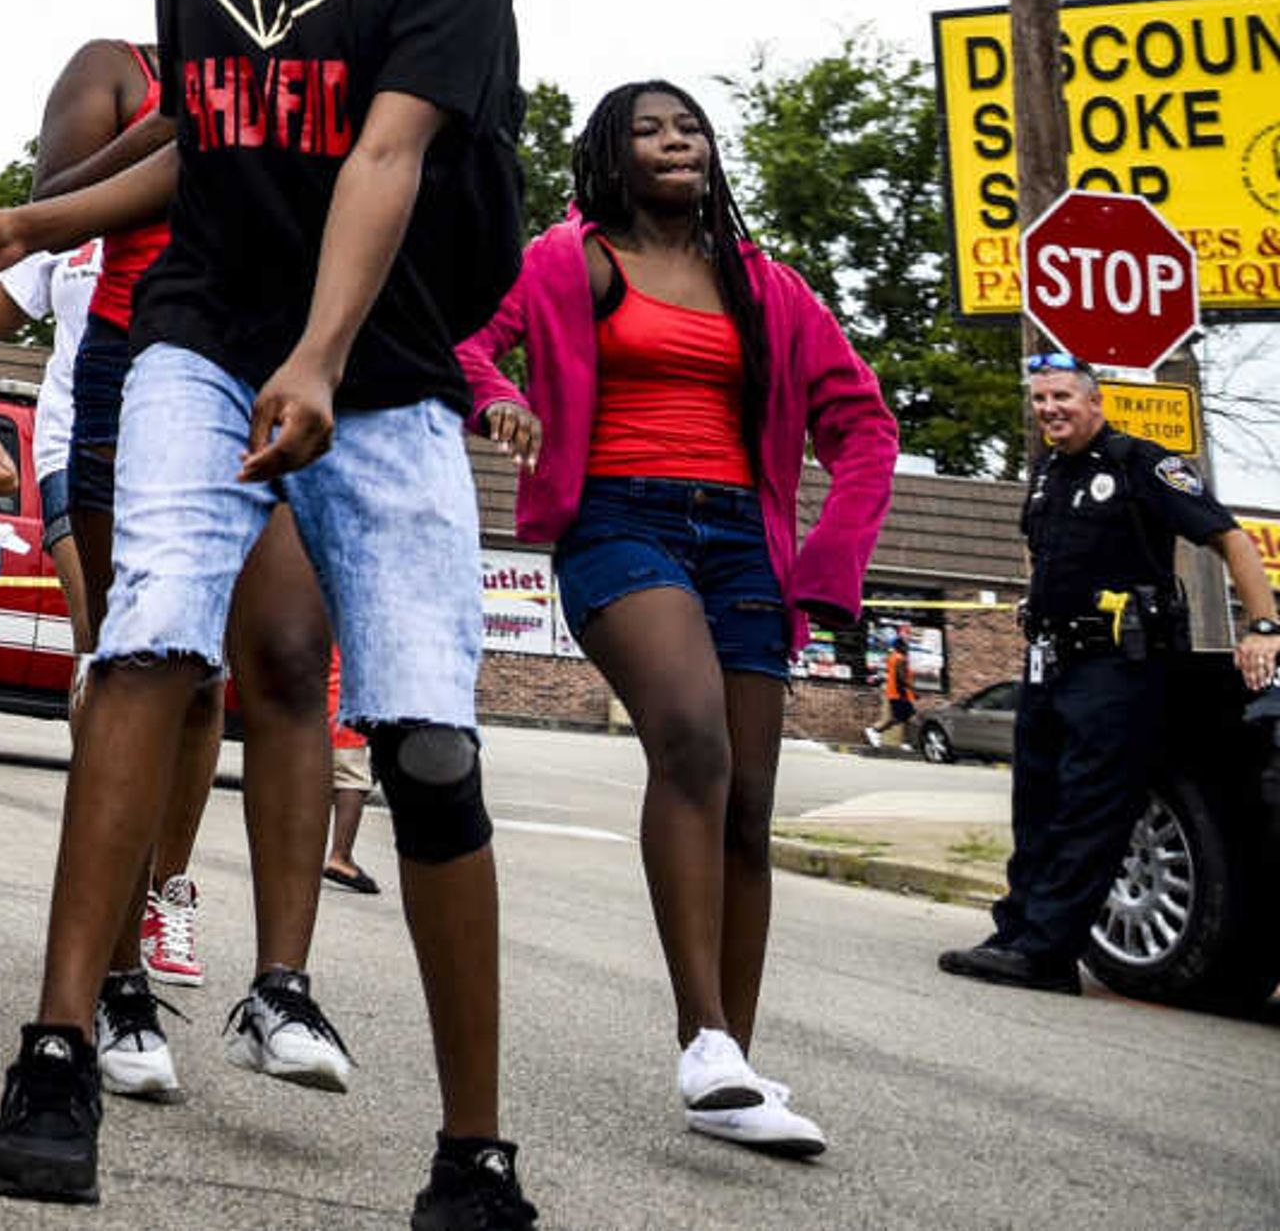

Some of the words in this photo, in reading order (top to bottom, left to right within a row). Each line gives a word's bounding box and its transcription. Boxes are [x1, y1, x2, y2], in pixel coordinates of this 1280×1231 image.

[966, 15, 1280, 91] DCOUN
[973, 89, 1225, 161] SOKE
[980, 165, 1170, 230] SP
[1036, 244, 1185, 316] STOP
[1114, 396, 1183, 417] TRAFFIC
[1143, 422, 1186, 439] STOP
